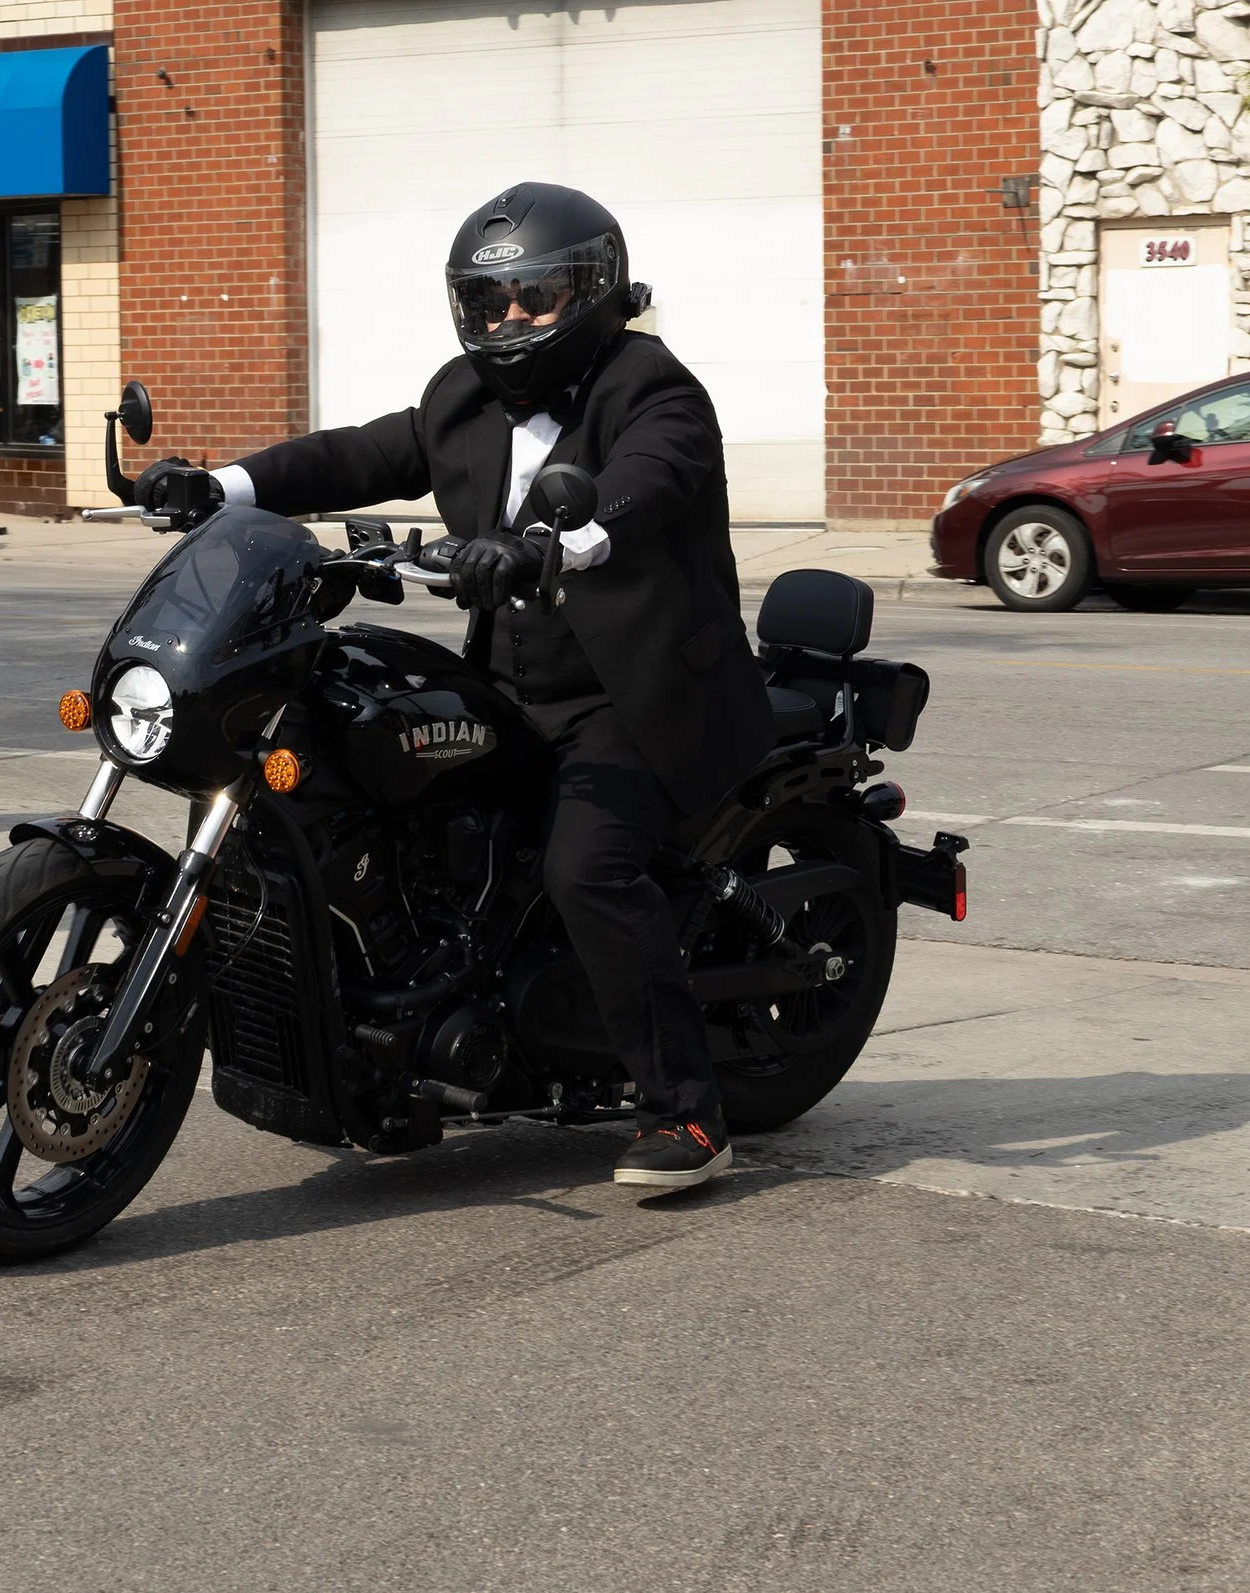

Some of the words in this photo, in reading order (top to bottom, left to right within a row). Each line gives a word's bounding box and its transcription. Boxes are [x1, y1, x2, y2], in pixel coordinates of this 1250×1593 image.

[477, 246, 517, 263] HJC
[1145, 240, 1191, 263] 3540
[128, 635, 162, 652] Indian
[399, 721, 486, 753] INDIAN
[434, 748, 458, 760] SCOUT
